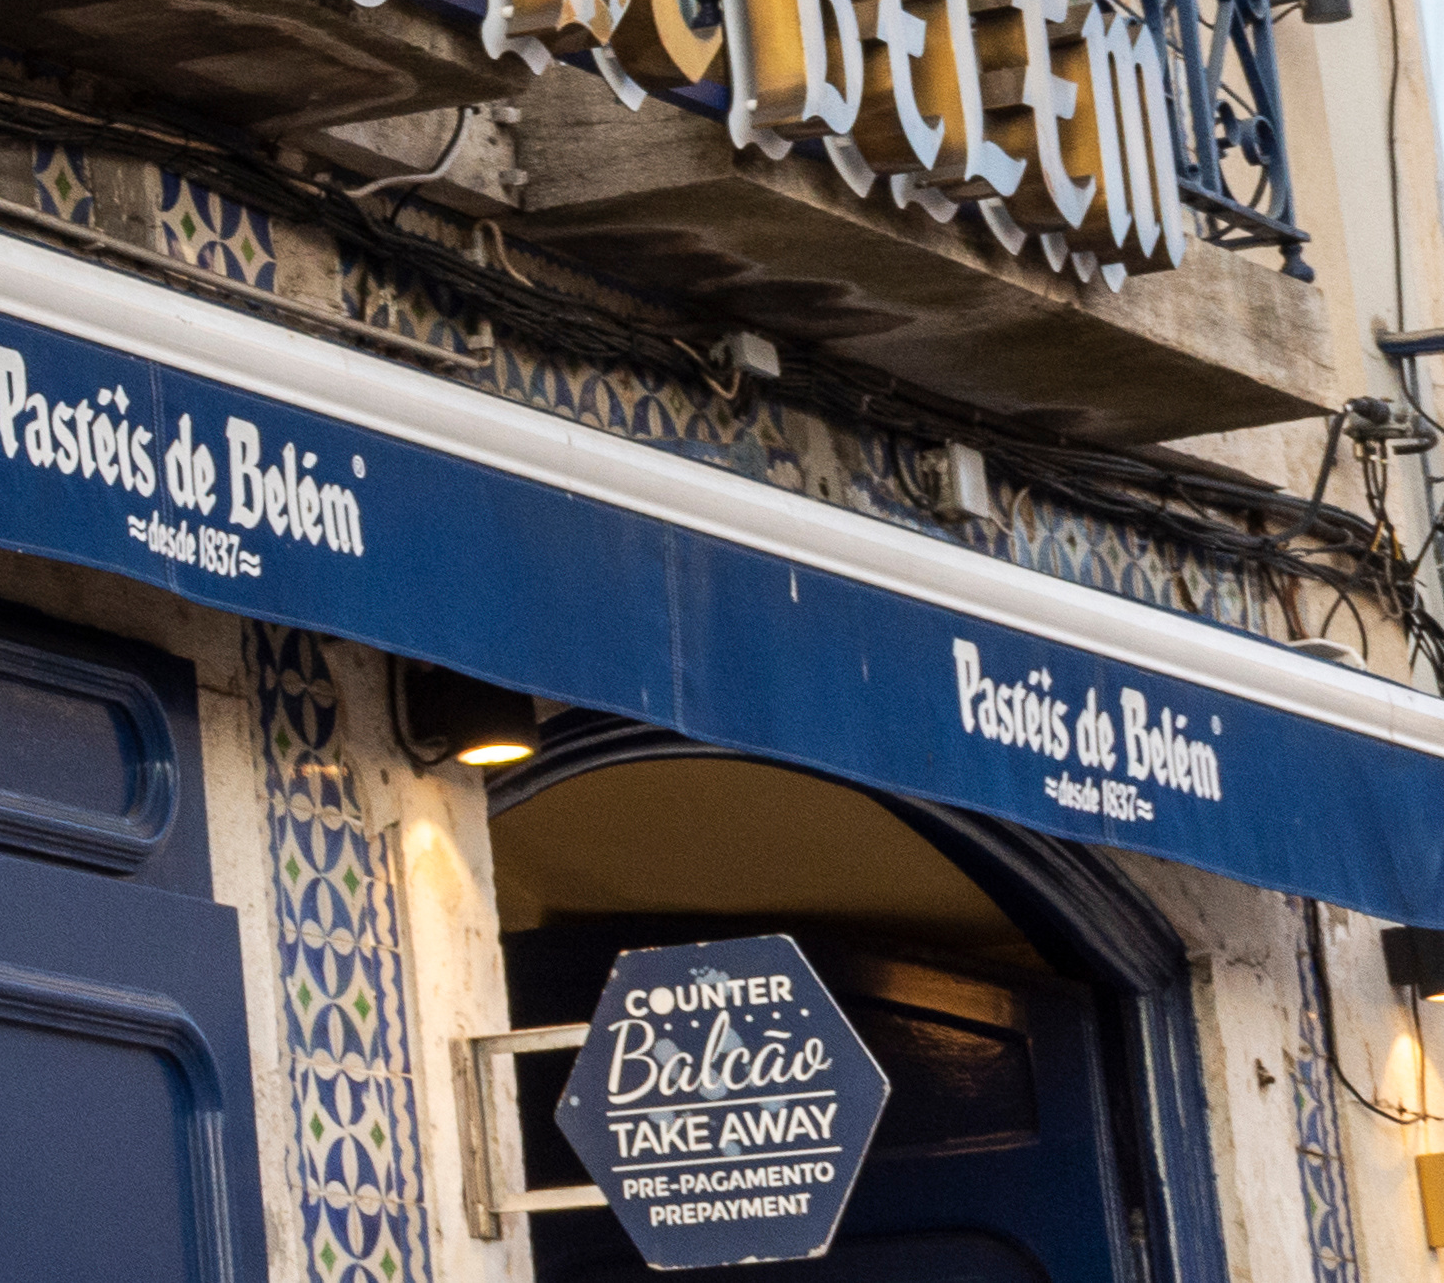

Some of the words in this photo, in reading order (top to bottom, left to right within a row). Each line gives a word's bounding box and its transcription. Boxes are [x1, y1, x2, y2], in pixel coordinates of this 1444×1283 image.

[165, 413, 217, 516] de
[148, 509, 197, 565] desde
[199, 524, 240, 578] 1837
[952, 637, 1069, 761] Pastéis
[1076, 687, 1117, 772] de
[1058, 770, 1100, 815] desde
[1102, 779, 1137, 822] 1837
[625, 974, 794, 1018] COUNTER
[607, 1010, 834, 1105] Balcão
[609, 1115, 714, 1158] TAKE
[718, 1103, 838, 1150] AWAY
[622, 1161, 836, 1200] PRE-PAGAMENTO
[649, 1193, 812, 1227] PREPAYMENT
